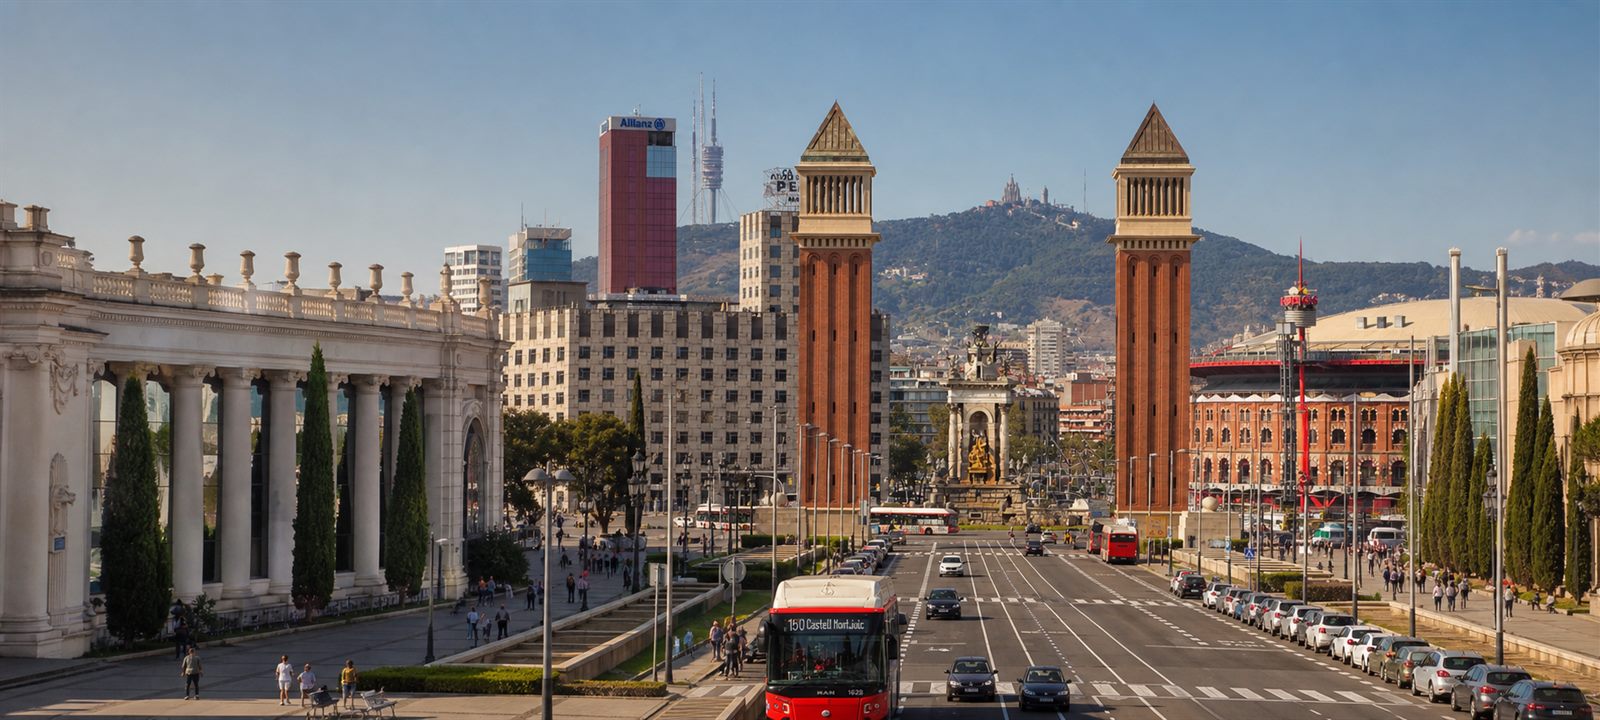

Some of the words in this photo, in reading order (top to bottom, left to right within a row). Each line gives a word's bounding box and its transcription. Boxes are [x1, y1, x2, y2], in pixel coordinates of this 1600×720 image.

[620, 118, 652, 128] Allianz
[777, 181, 799, 192] PE
[788, 618, 805, 631] 150
[806, 618, 832, 630] Castell
